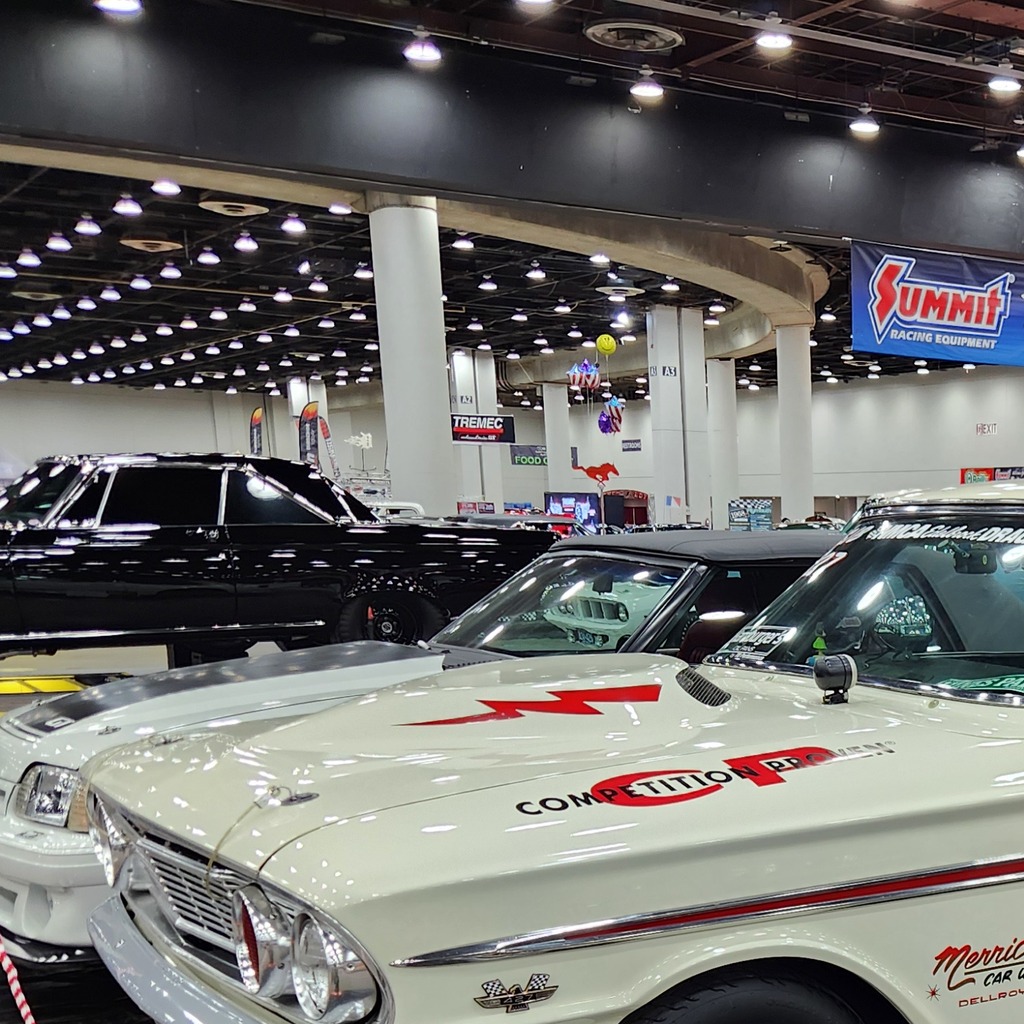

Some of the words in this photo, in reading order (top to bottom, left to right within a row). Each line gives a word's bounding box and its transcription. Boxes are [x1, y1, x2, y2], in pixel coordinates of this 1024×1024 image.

[890, 329, 933, 344] RACING
[935, 335, 997, 350] EQUIPMENT
[663, 366, 677, 377] A3
[453, 416, 504, 429] TREMEC
[515, 455, 541, 465] FOOD
[516, 765, 760, 816] COMPETITION
[763, 740, 894, 773] PROVEN
[983, 969, 1013, 987] CAR
[503, 993, 535, 1005] 427
